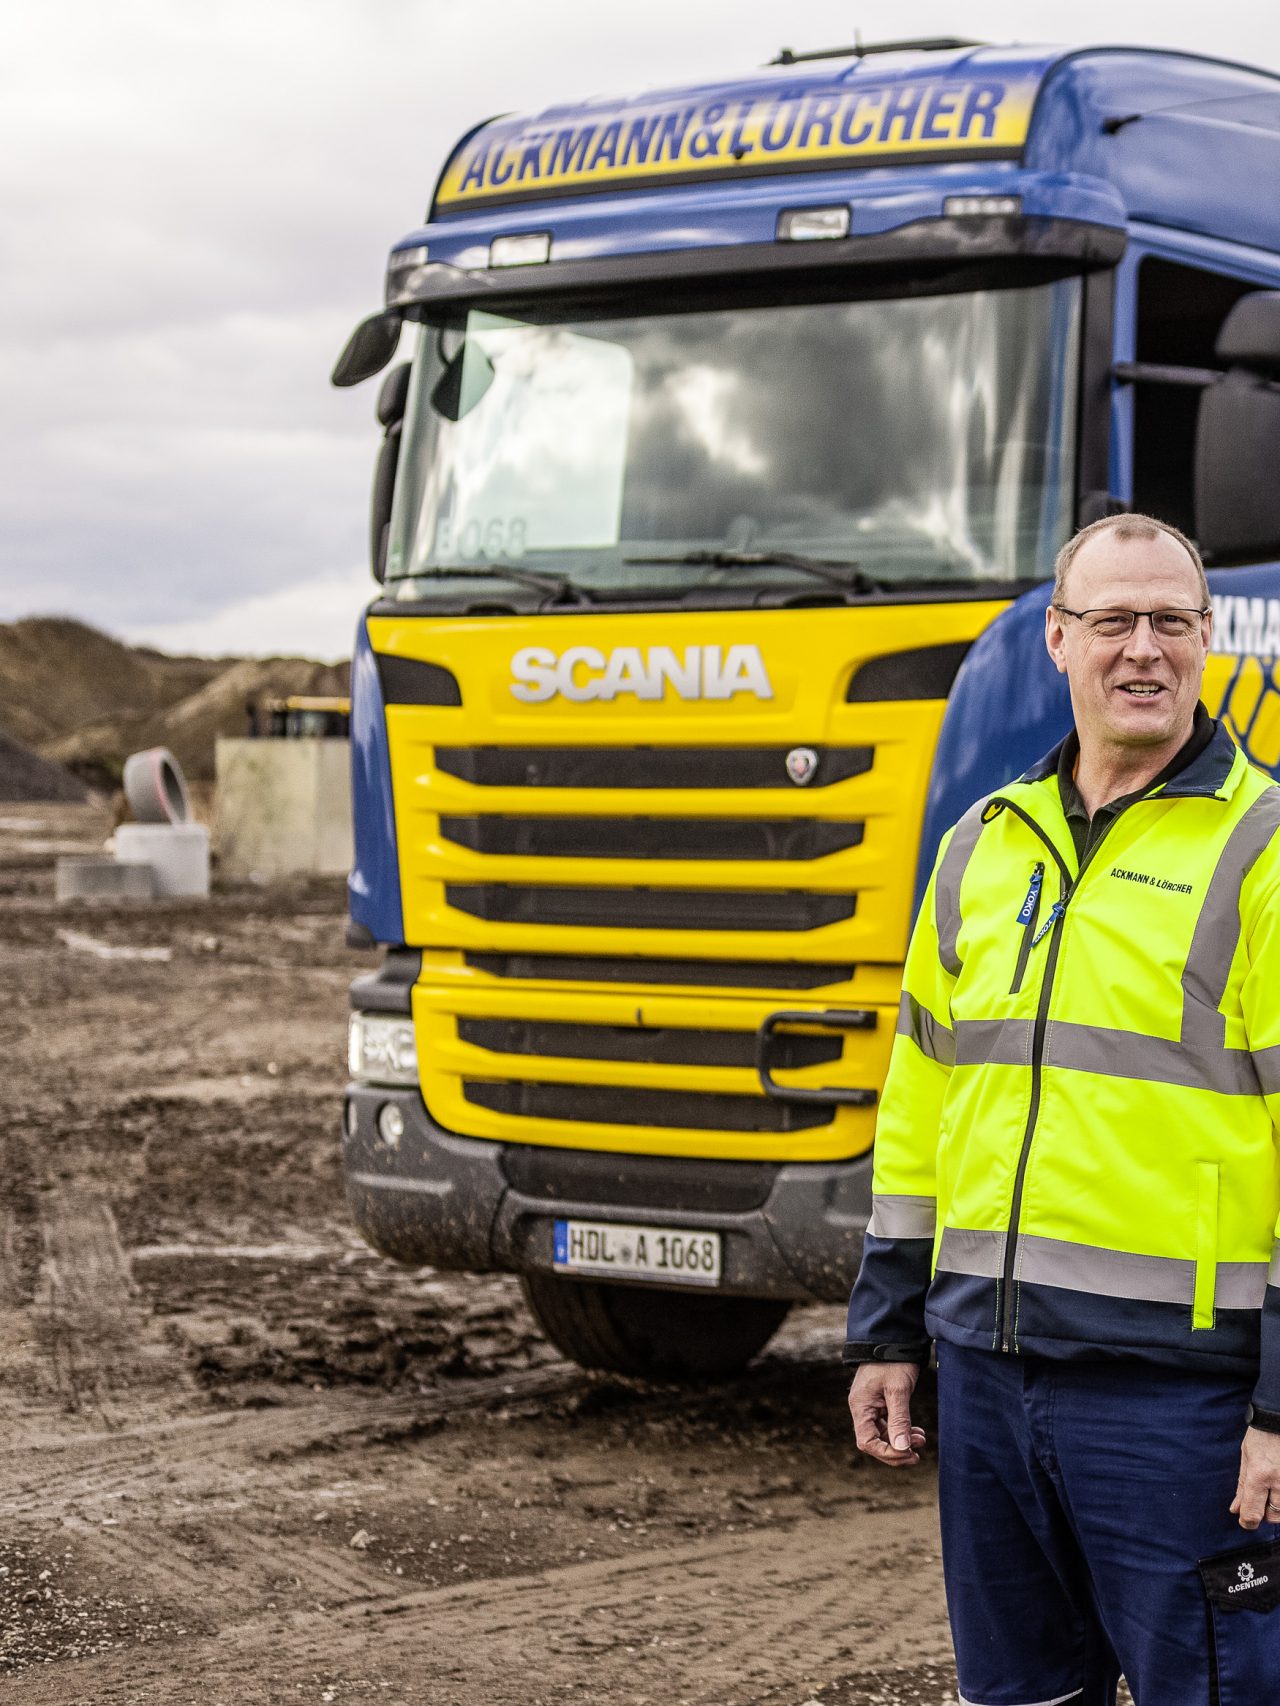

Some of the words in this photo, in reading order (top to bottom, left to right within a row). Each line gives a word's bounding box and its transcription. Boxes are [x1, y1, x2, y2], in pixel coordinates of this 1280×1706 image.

[509, 644, 774, 702] SCANIA
[1110, 868, 1150, 884] ACKMANN
[1149, 876, 1156, 886] &
[1156, 879, 1193, 895] LÖRCHER
[1022, 890, 1038, 917] YOKO
[570, 1229, 615, 1262] HDL
[635, 1235, 649, 1265] A
[656, 1237, 714, 1271] 1068
